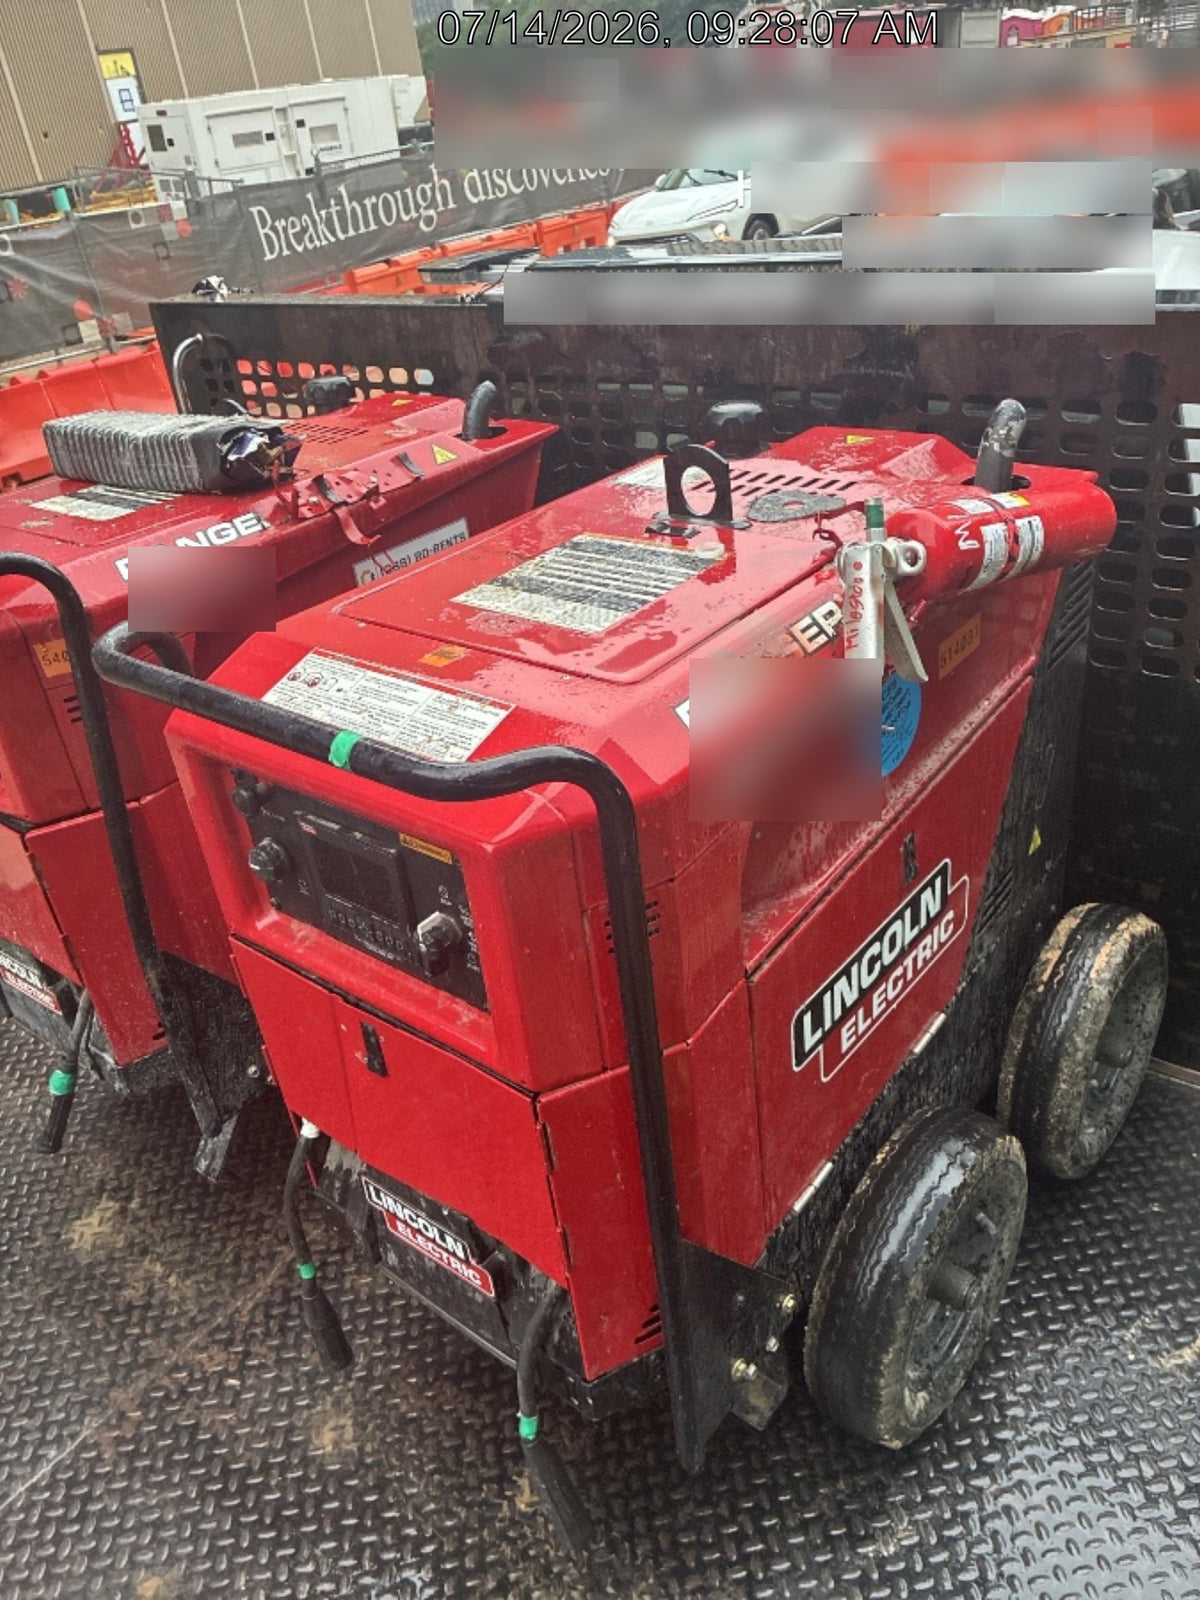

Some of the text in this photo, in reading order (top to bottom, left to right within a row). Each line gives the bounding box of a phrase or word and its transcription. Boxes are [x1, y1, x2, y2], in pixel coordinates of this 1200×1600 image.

[249, 164, 457, 261] Breakthrough
[802, 875, 942, 1053] LINCOLN
[840, 909, 955, 1054] ELECTRIC
[368, 1184, 467, 1260] LINCOLN
[395, 1220, 482, 1286] ELECTRIC
